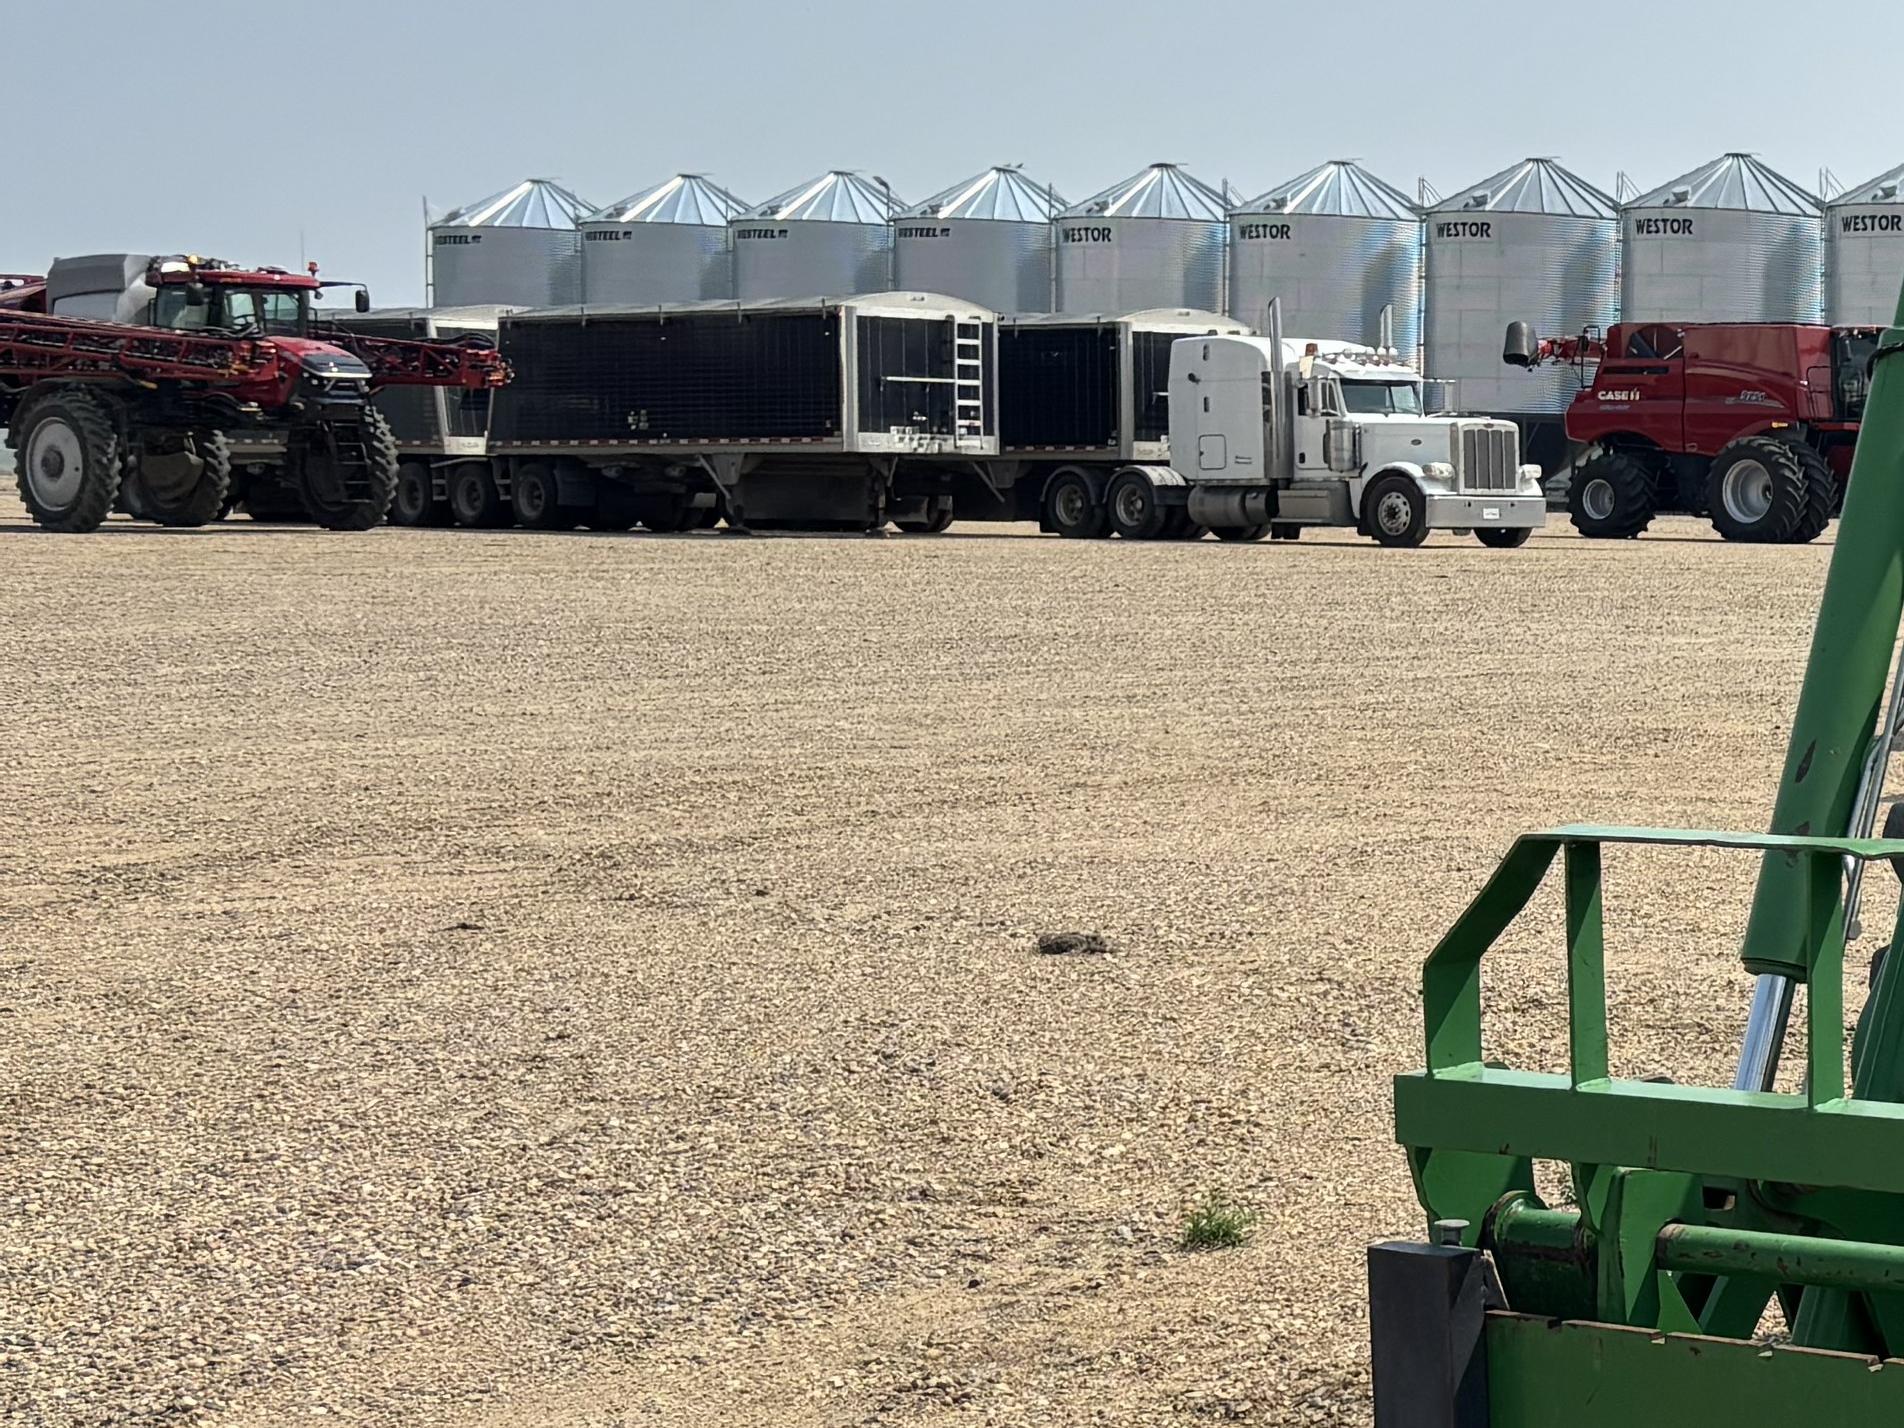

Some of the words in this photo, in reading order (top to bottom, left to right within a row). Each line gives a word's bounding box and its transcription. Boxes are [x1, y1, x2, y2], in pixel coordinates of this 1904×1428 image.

[1436, 221, 1491, 238] WESTOR
[1636, 217, 1693, 235] WESTOR
[1842, 214, 1902, 232] WESTOR
[1062, 226, 1112, 243] WESTOR
[1239, 224, 1291, 240] WESTOR
[1597, 390, 1629, 401] CASE
